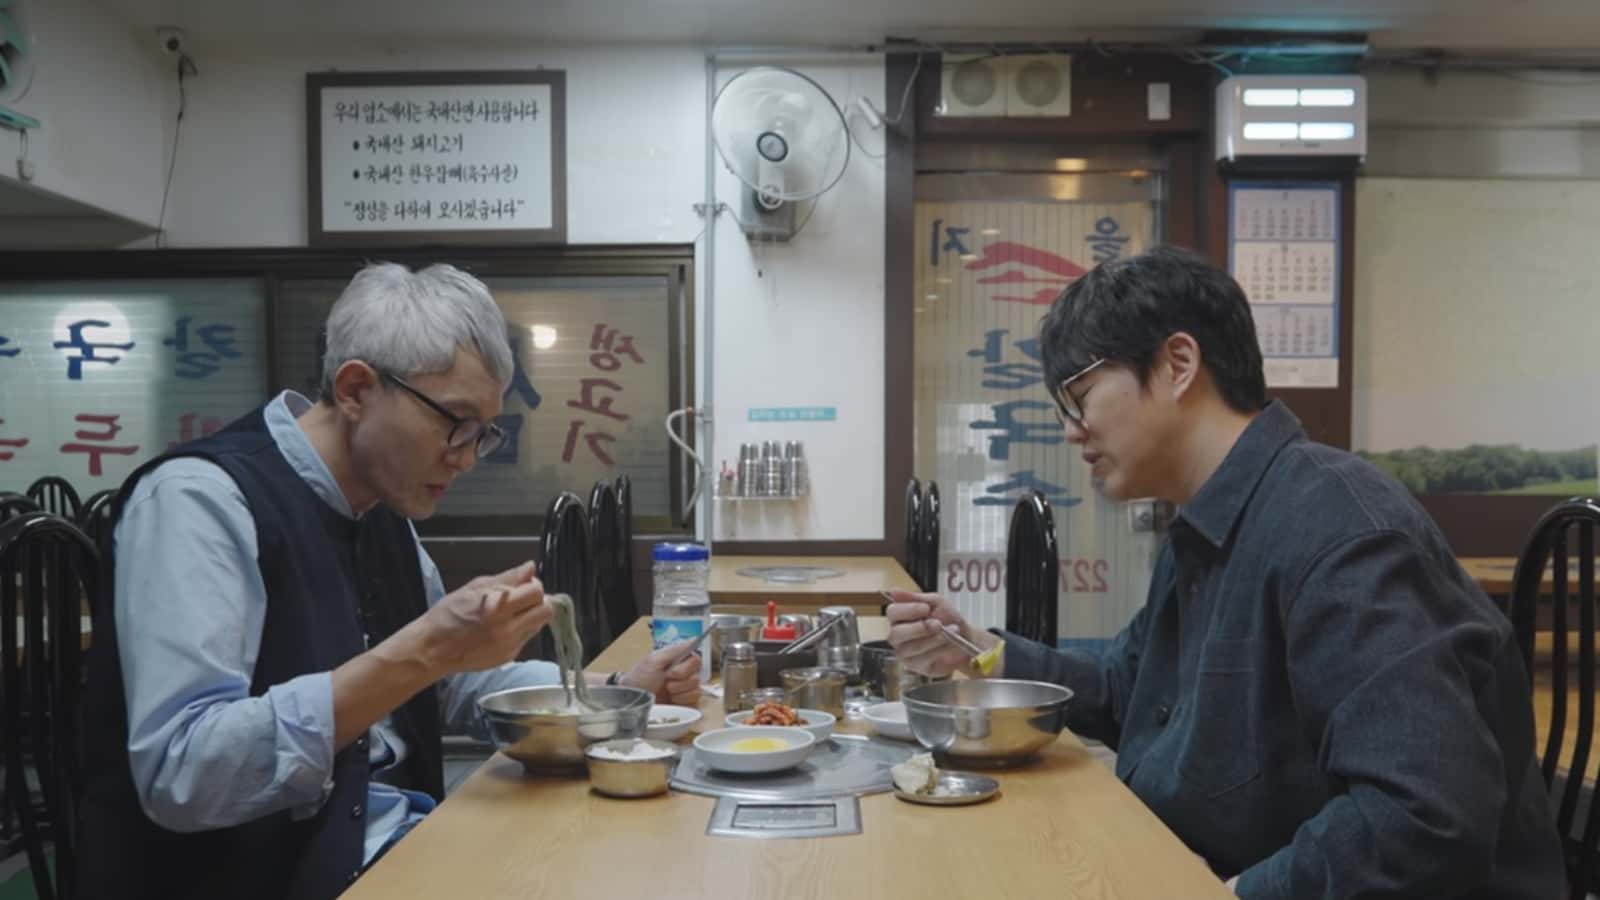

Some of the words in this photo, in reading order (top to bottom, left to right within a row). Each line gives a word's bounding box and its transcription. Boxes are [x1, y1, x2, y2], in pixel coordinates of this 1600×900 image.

[335, 100, 360, 123] 우리
[362, 99, 422, 124] 업소에서는
[363, 133, 405, 155] 국내산
[409, 132, 464, 153] 돼지고기
[363, 163, 404, 185] 국내산
